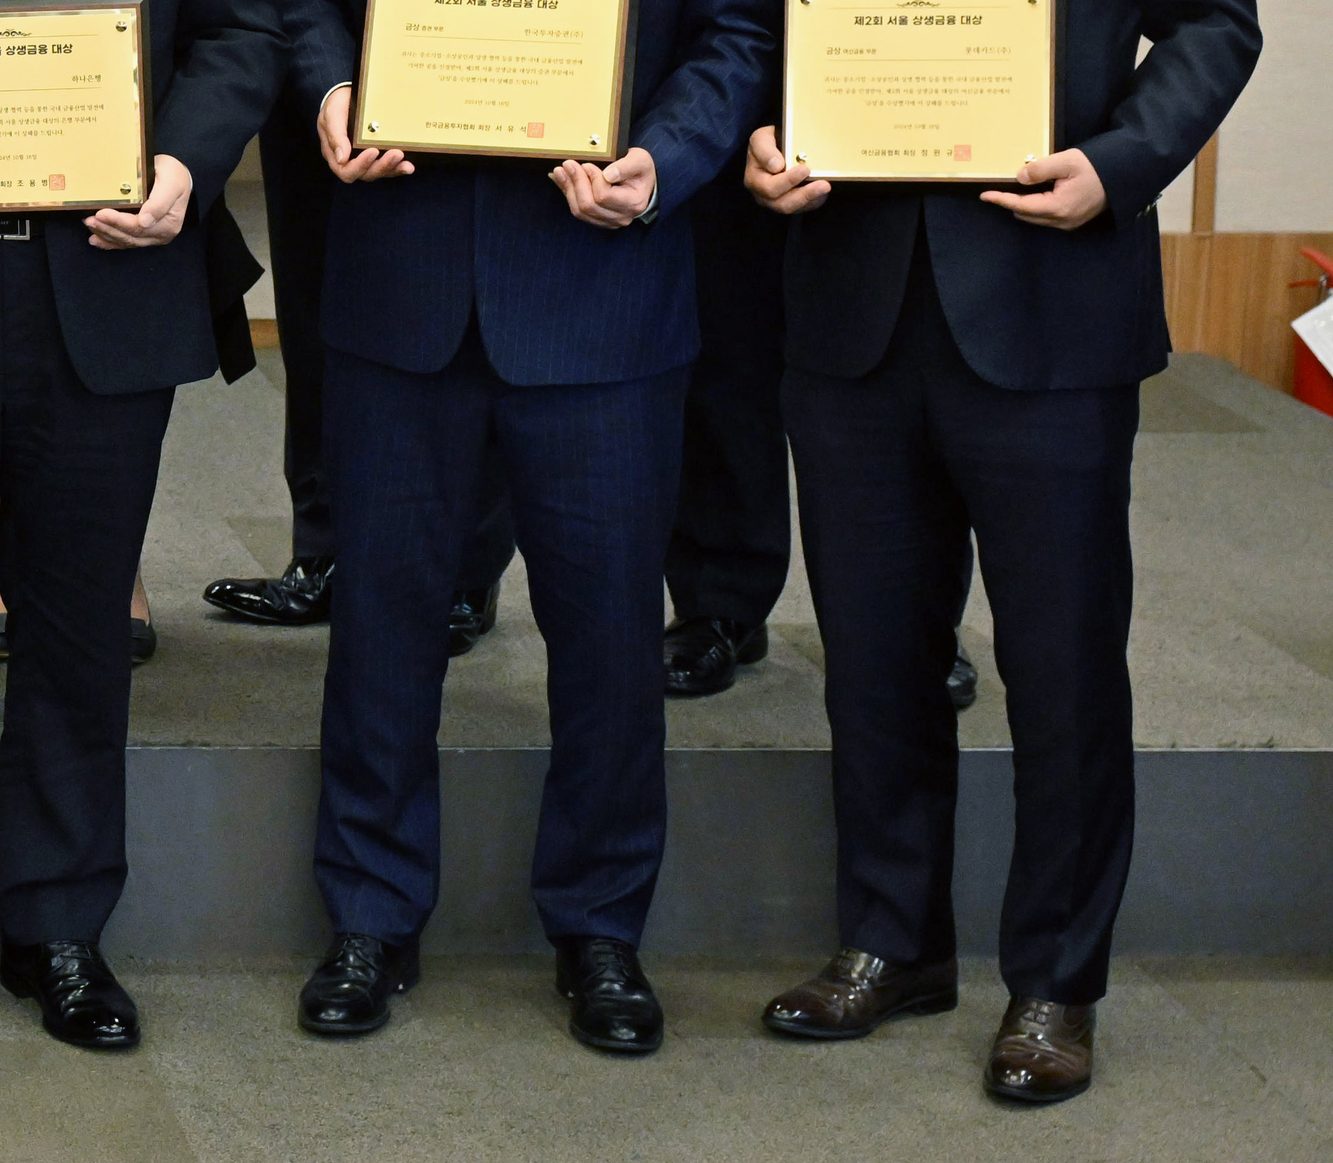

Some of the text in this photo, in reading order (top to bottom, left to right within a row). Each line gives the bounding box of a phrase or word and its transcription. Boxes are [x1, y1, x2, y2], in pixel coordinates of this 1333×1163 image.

[537, 0, 558, 9] 대상
[854, 15, 982, 26] 제2회 서울 상생금융 대상
[405, 23, 419, 31] 금상
[6, 44, 47, 55] 상생금융
[52, 43, 73, 54] 대상
[826, 47, 841, 55] 금상
[72, 74, 101, 82] 하나은행
[0, 180, 12, 188] 회장
